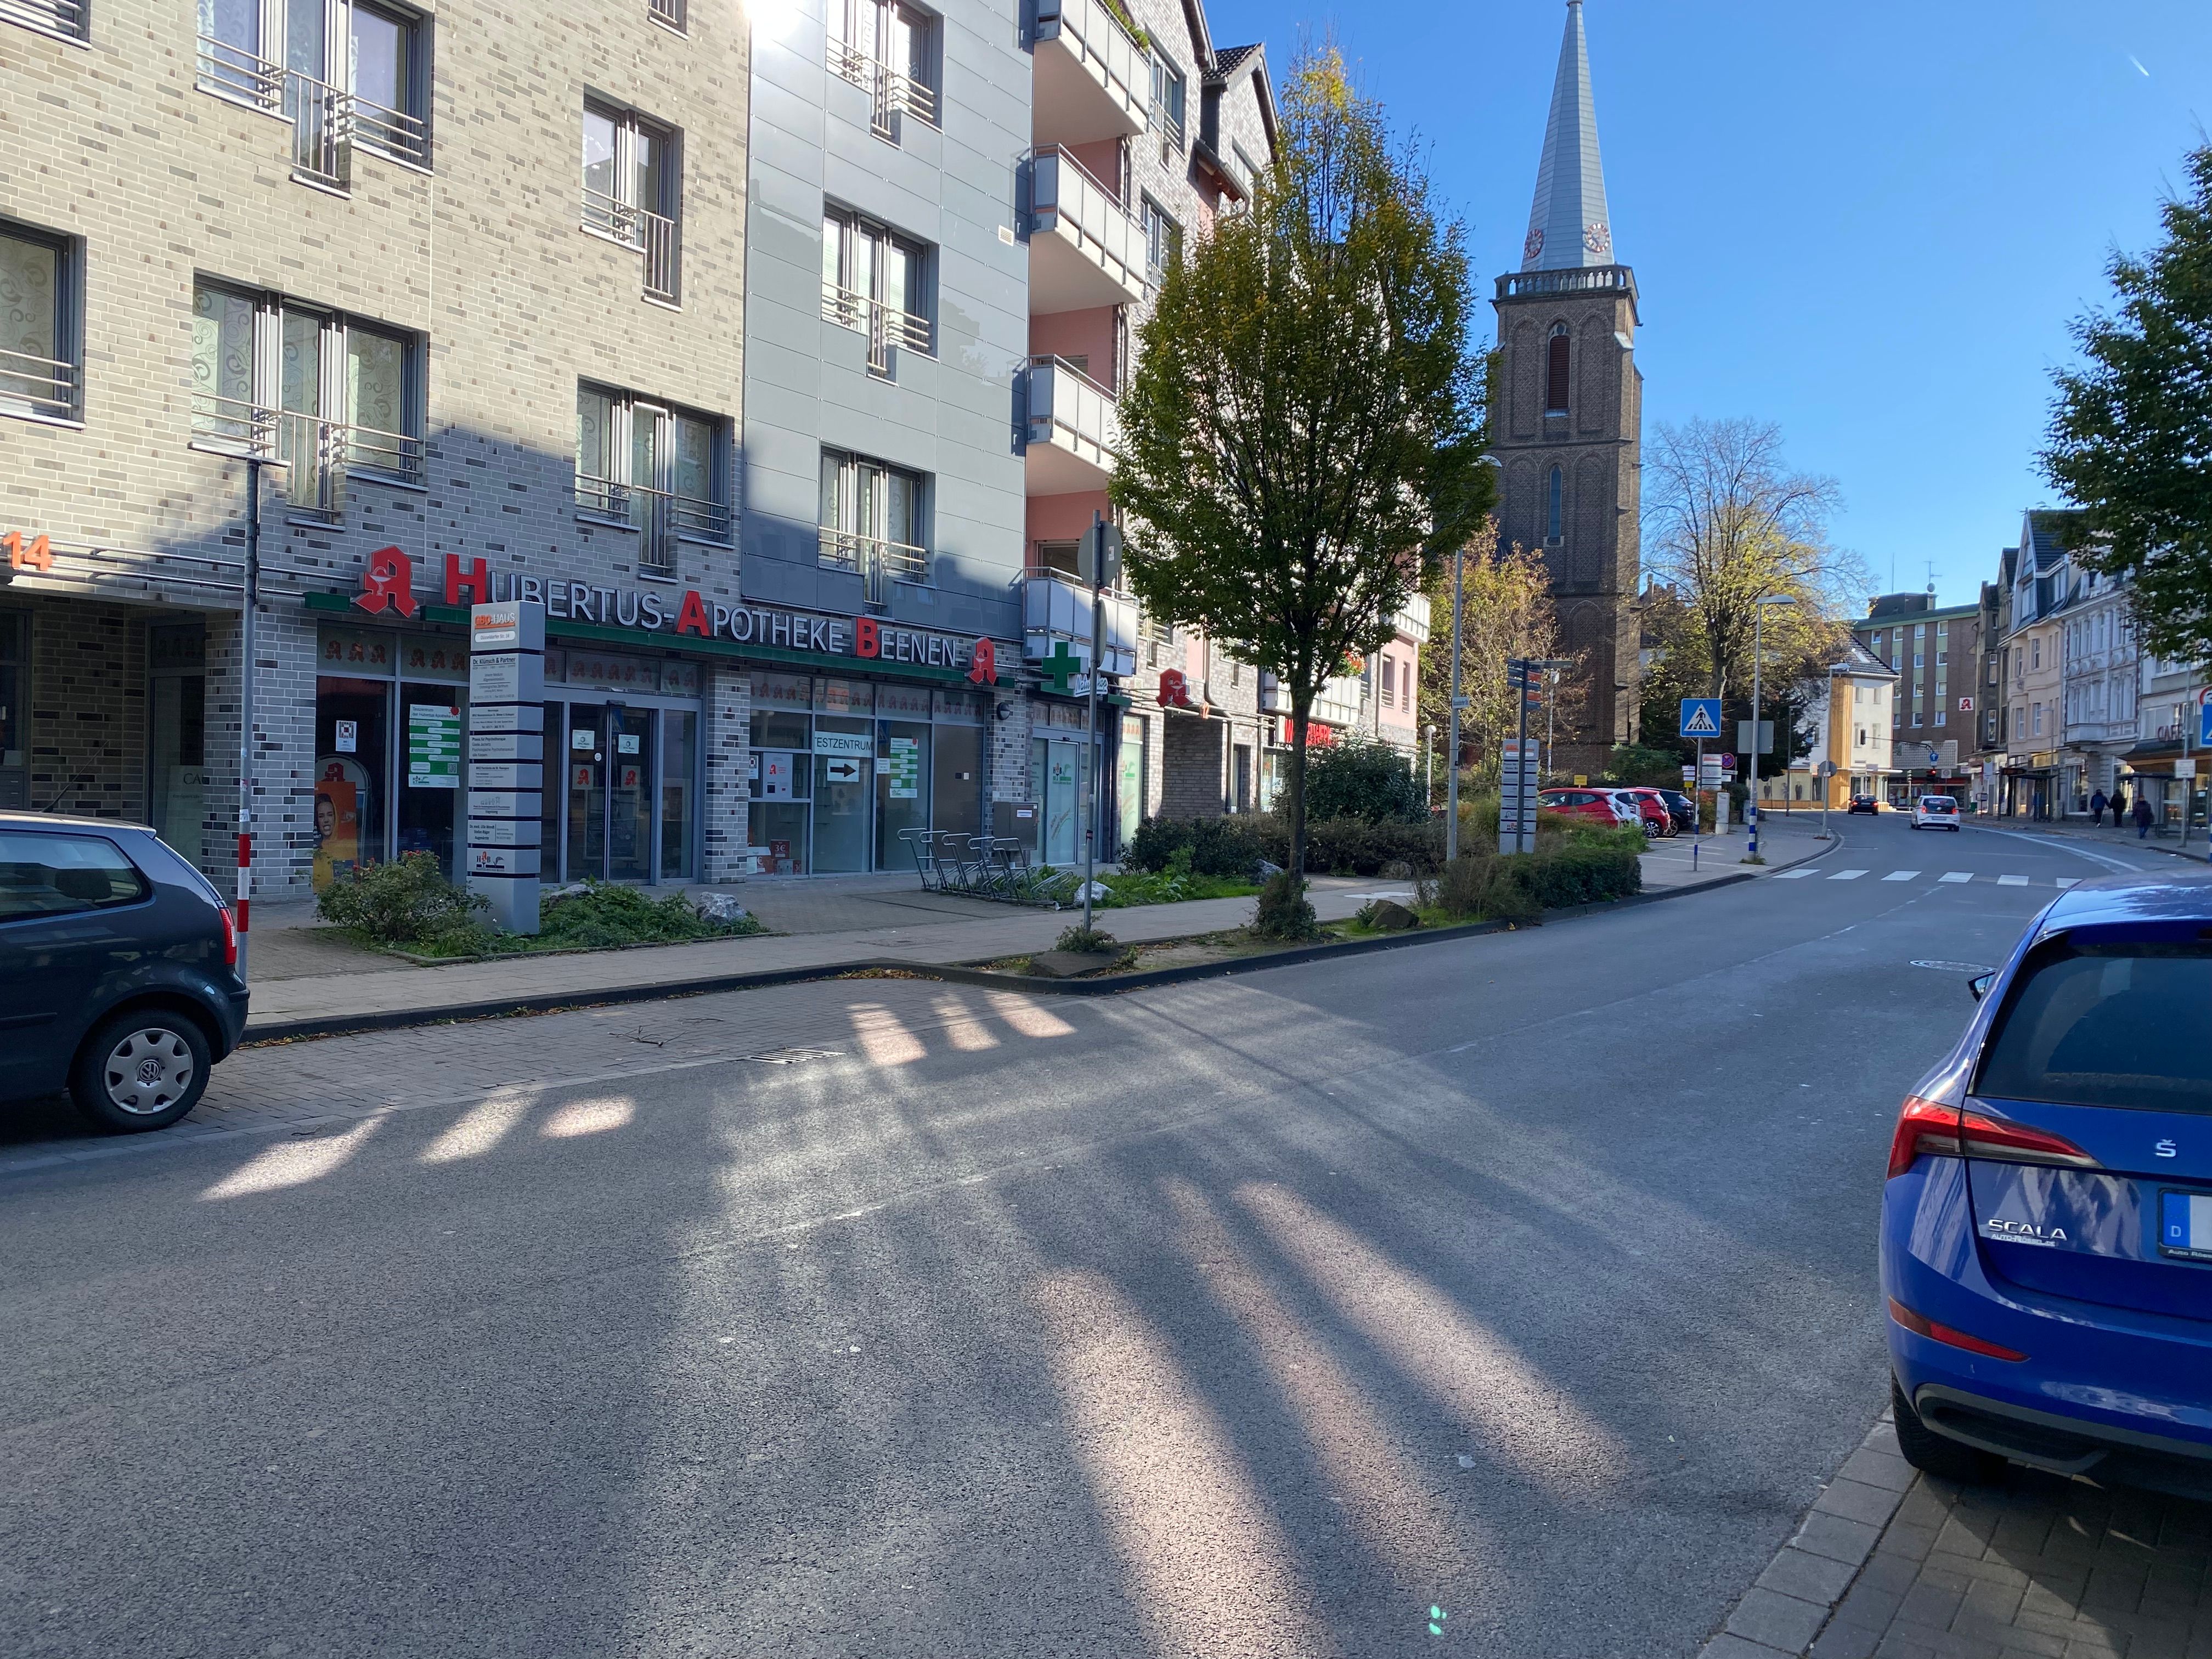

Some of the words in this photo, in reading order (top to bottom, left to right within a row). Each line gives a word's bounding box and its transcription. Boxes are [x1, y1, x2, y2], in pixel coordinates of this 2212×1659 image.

[3, 531, 53, 571] 14
[852, 617, 956, 667] BEENEN
[815, 737, 874, 751] ESTZENTRUM
[1988, 1219, 2067, 1241] SCALA
[2171, 1225, 2181, 1237] D
